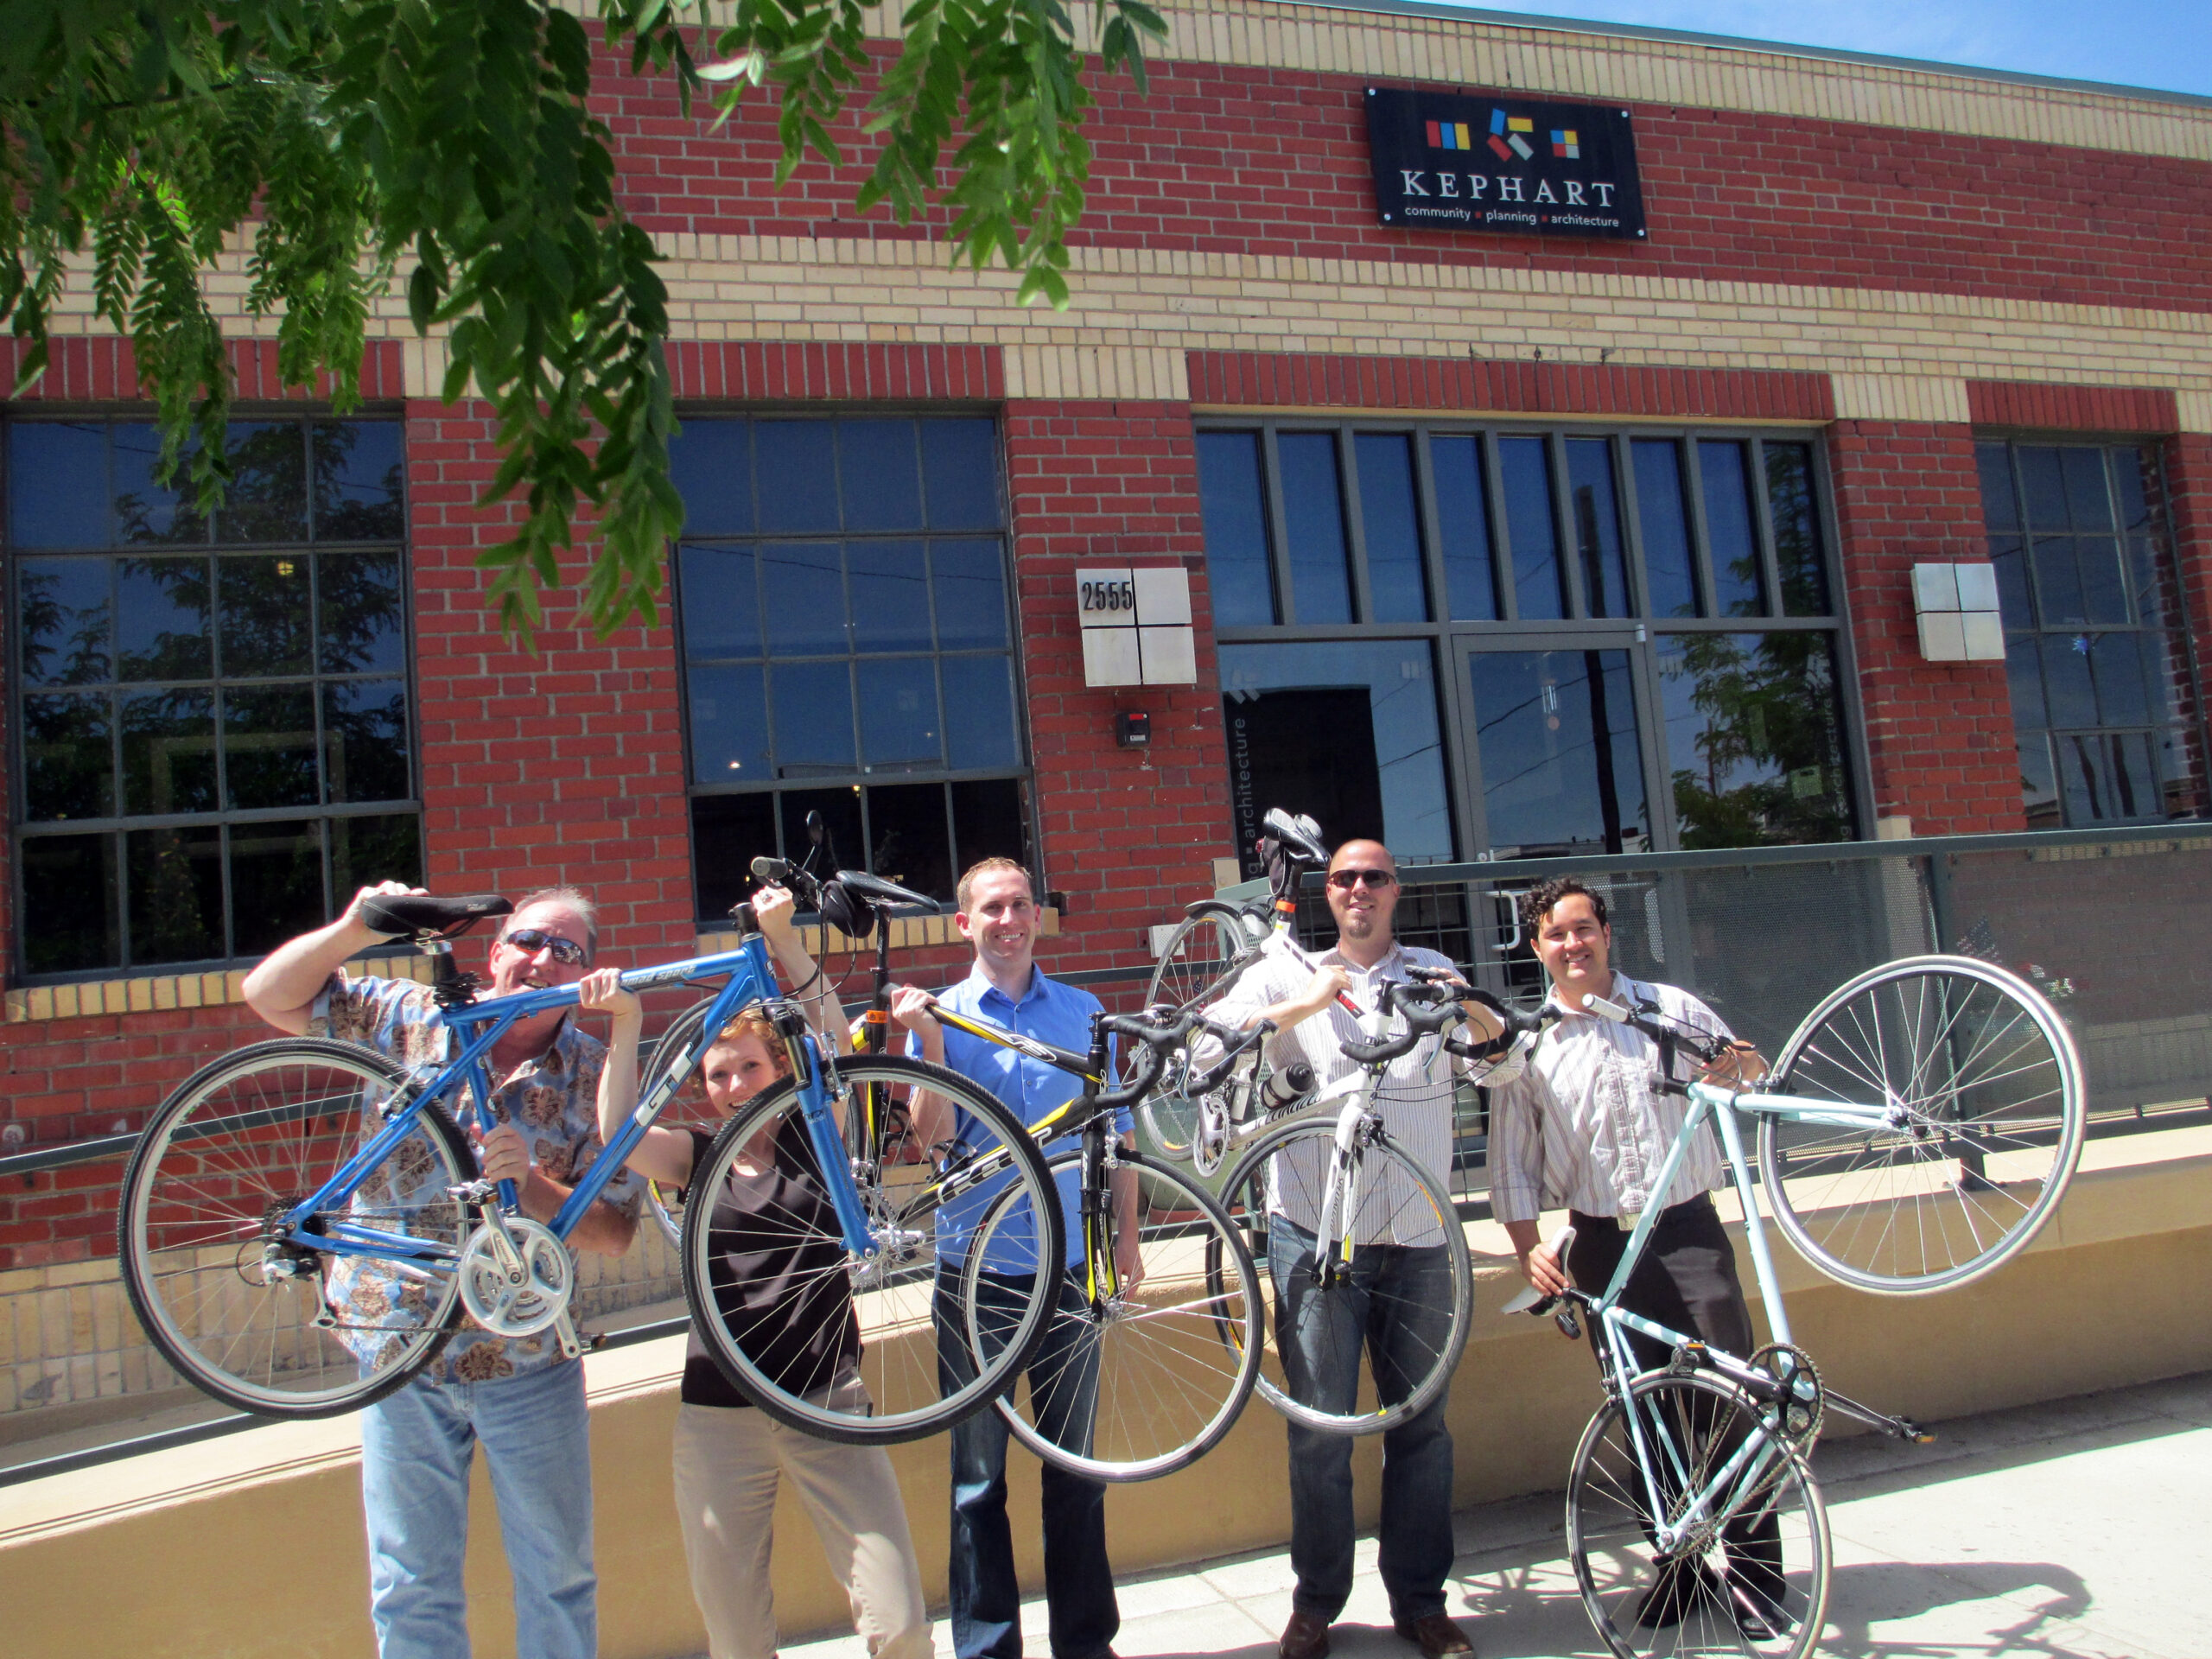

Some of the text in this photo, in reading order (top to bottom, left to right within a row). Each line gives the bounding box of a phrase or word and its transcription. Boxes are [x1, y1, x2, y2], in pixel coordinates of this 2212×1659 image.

[1400, 169, 1615, 207] KEPHART
[1405, 206, 1619, 227] community planning architecture
[1082, 581, 1133, 611] 2555
[1235, 717, 1255, 838] architecture
[1823, 697, 1847, 804] architecture
[633, 1041, 694, 1127] GT
